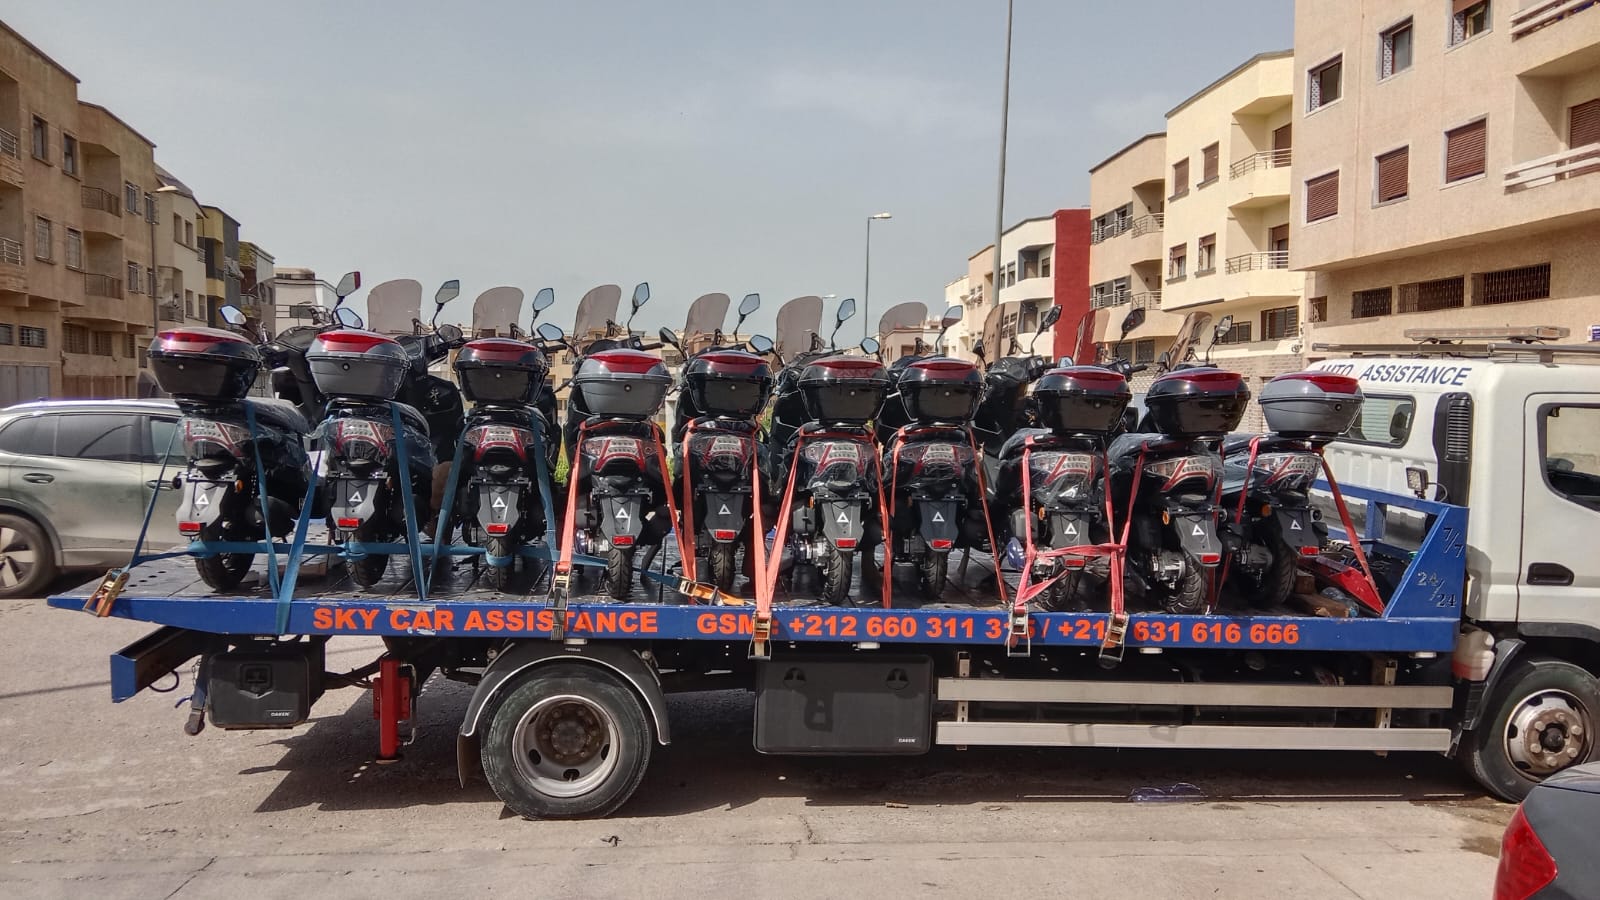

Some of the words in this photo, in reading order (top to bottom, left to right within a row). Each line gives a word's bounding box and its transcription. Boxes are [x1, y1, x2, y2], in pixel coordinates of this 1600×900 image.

[1320, 364, 1354, 376] TO
[1359, 364, 1472, 386] ASSISTANCE
[313, 608, 379, 630] SKY
[389, 608, 455, 631] CAR
[463, 609, 658, 633] ASSISTANCE
[789, 615, 857, 637] +212
[866, 616, 917, 638] 660
[926, 616, 974, 638] 311
[1058, 618, 1108, 640] +21
[1133, 621, 1180, 641] 631
[1191, 621, 1241, 643] 616
[1250, 623, 1299, 644] 666
